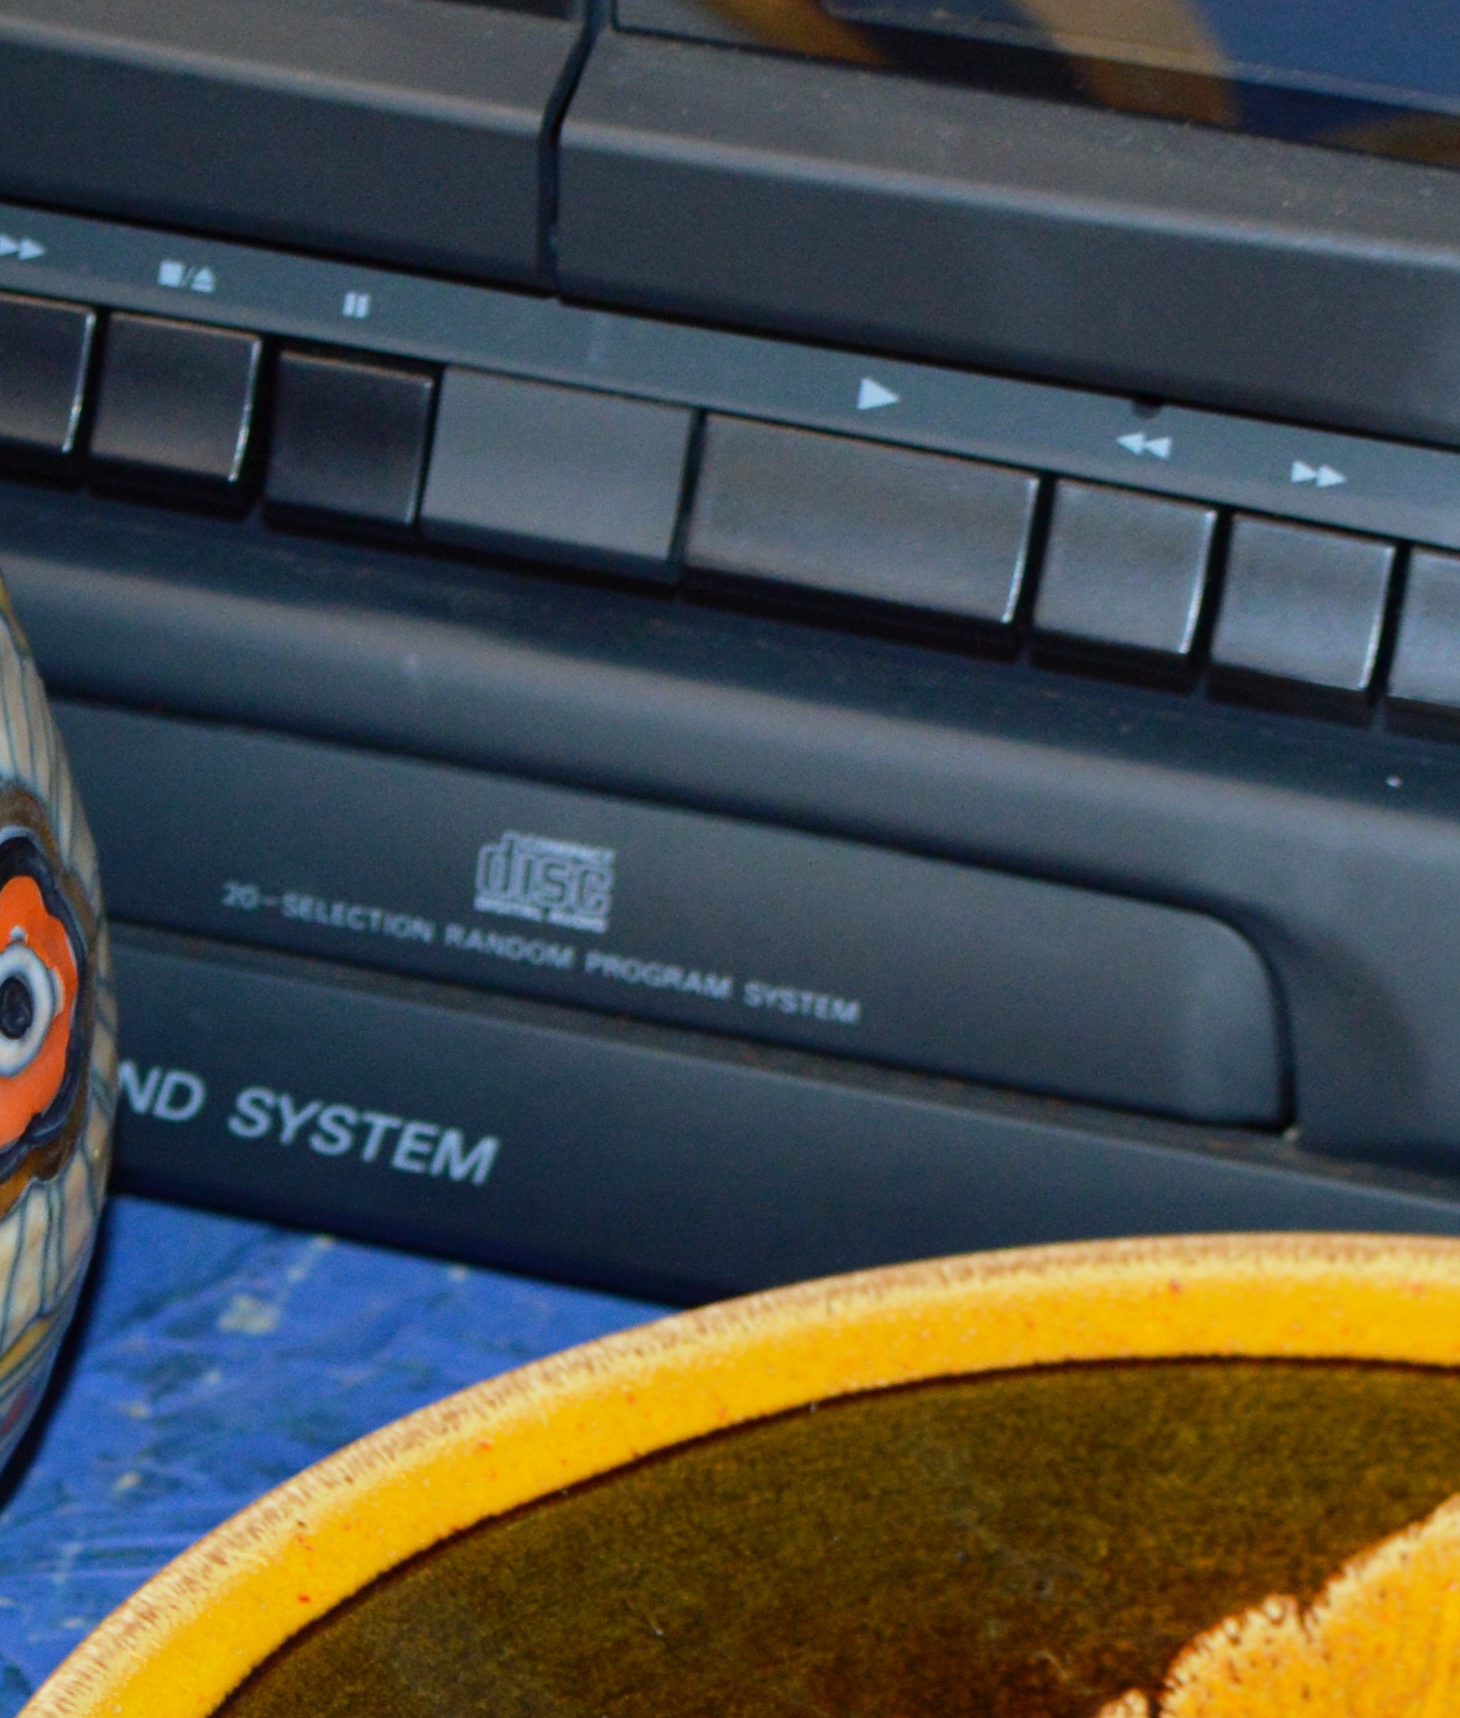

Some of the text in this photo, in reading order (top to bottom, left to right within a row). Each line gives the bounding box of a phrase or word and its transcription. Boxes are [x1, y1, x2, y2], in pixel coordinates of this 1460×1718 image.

[444, 922, 575, 969] RANDOM
[584, 950, 733, 999] PROGRAM
[743, 980, 861, 1025] SYSTEM
[227, 1085, 500, 1186] SYSTEM
